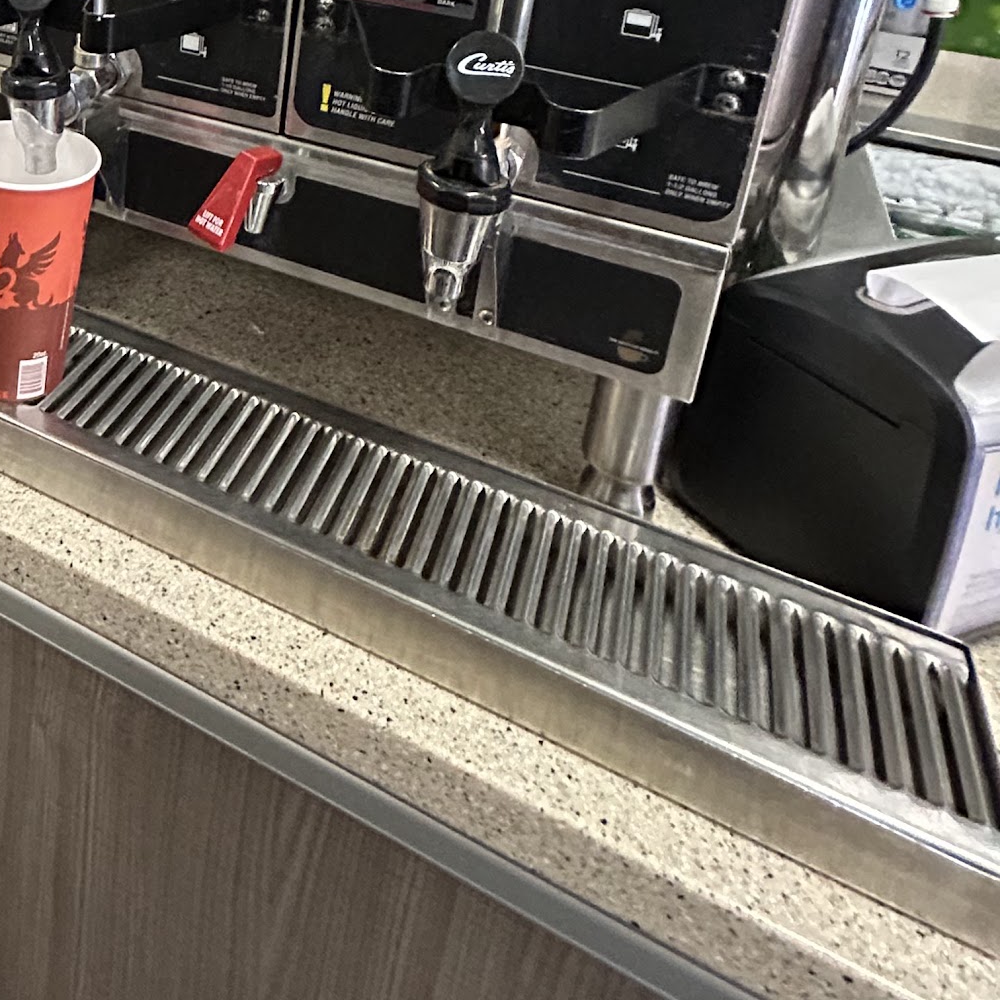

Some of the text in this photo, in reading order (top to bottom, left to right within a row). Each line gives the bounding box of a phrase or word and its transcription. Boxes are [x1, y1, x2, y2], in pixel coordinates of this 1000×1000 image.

[437, 0, 456, 8] DARK
[458, 53, 516, 78] Curtis
[333, 90, 363, 102] WARNIN
[332, 98, 345, 108] HOT
[331, 106, 396, 128] HANDLE WITH CARE
[195, 214, 224, 237] HOT WATER
[212, 215, 224, 228] FOR
